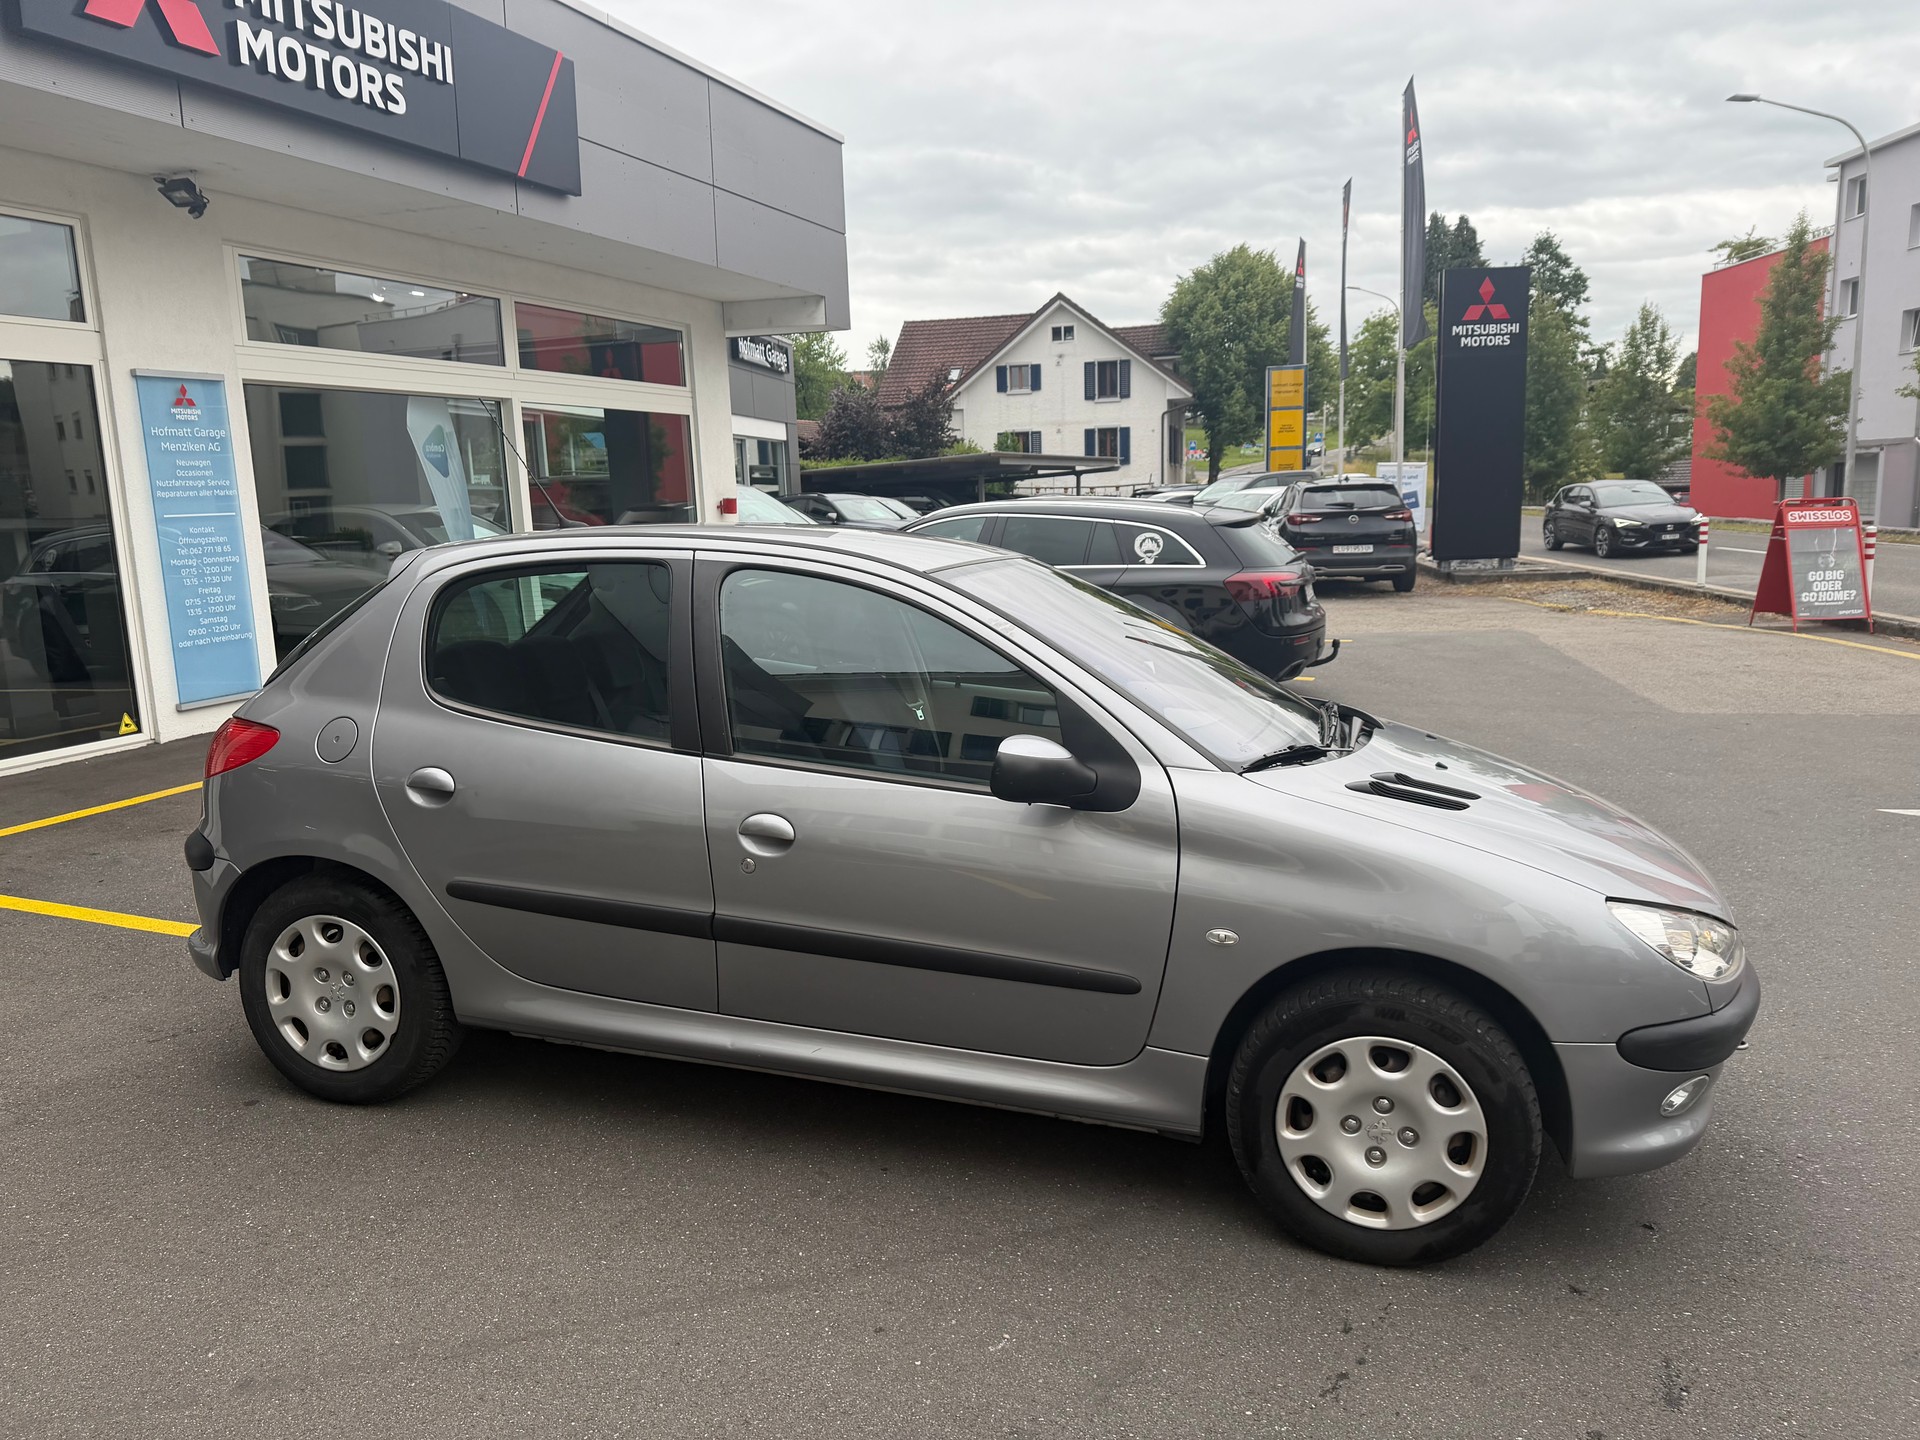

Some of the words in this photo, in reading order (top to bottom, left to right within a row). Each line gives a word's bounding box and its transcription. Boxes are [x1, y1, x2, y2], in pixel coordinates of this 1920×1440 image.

[237, 20, 406, 114] MOTORS
[1452, 323, 1520, 336] MITSUBISHI
[1460, 335, 1510, 347] MOTORS
[738, 336, 766, 360] Hofmatt
[766, 344, 788, 372] Garage
[151, 427, 192, 436] Hofmatt
[194, 427, 226, 439] Garage
[161, 442, 206, 451] Menziken
[208, 442, 220, 451] AG
[157, 490, 198, 498] Reparaturen
[1789, 510, 1851, 522] SWISSLOS
[171, 558, 196, 567] Montag
[203, 555, 239, 564] Donnerstag
[1808, 571, 1824, 581] GO
[1825, 570, 1845, 580] BIG
[198, 587, 221, 595] Freitag
[1813, 581, 1842, 591] ODER
[1802, 592, 1817, 602] GO
[1818, 590, 1857, 601] HOME?
[200, 616, 228, 624] Samstag
[212, 632, 252, 643] Vereinbarung
